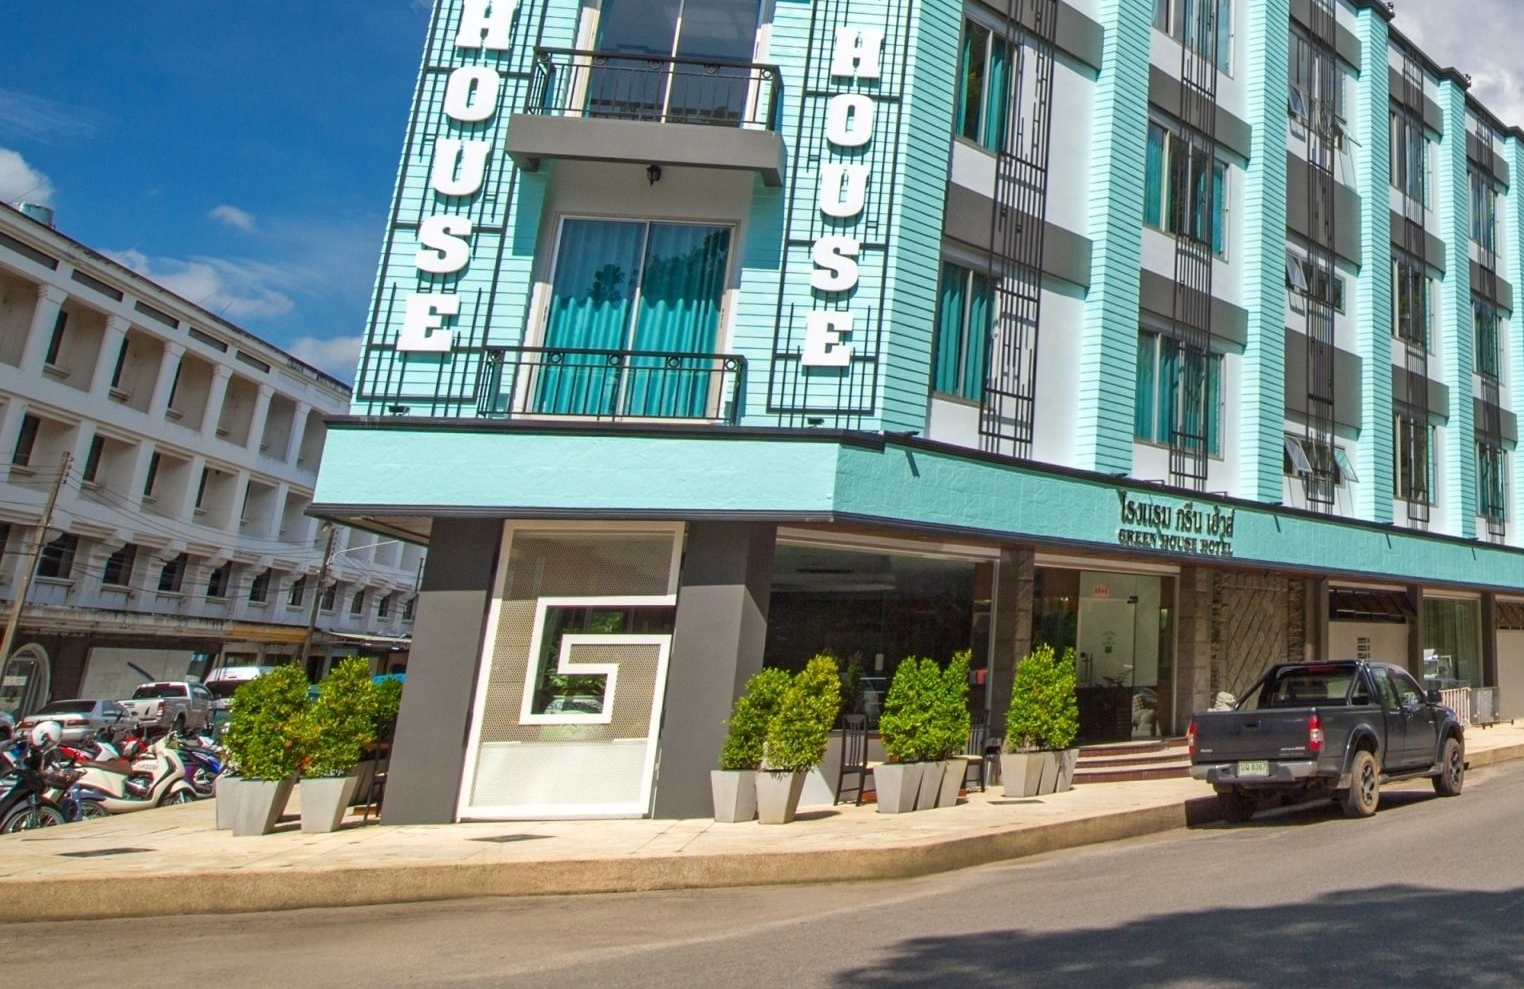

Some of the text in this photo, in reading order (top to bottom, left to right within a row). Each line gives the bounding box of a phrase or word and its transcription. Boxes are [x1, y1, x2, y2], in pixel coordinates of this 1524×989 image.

[794, 22, 886, 367] HOUSE
[1121, 492, 1171, 529] โรงแรม
[1175, 500, 1202, 534] กรีน
[1118, 529, 1233, 557] GREEN HOUSE HOTEL
